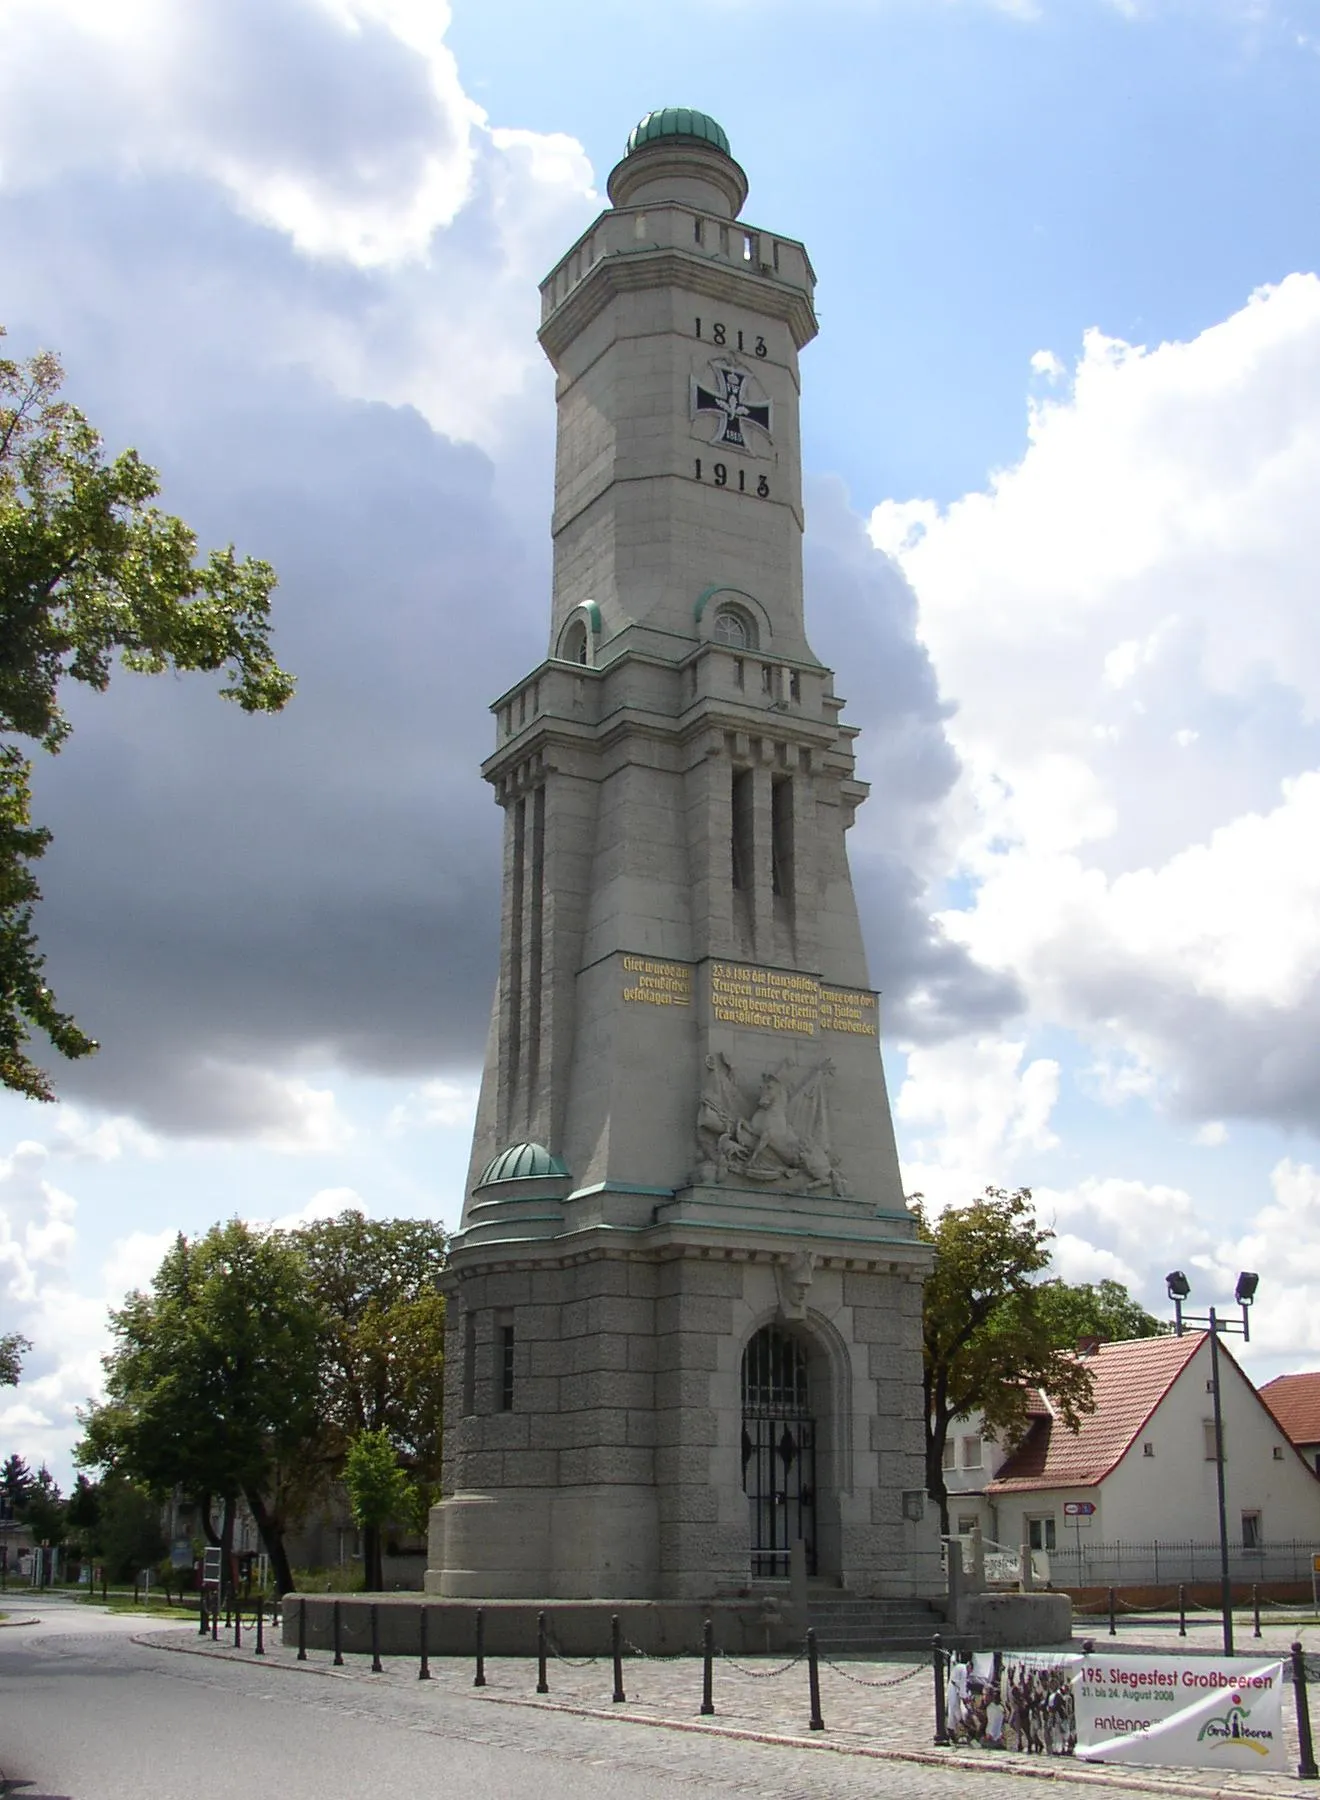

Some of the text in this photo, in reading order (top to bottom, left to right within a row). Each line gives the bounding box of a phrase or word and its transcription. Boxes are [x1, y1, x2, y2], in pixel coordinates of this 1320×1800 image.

[695, 317, 768, 358] 1813
[695, 458, 770, 498] 1913
[623, 955, 644, 972] Hier
[645, 961, 675, 977] wurde
[751, 969, 766, 984] die
[767, 972, 818, 992] französische
[623, 987, 672, 1005] geschlagen
[712, 992, 728, 1007] Der
[728, 994, 748, 1010] Sieg
[791, 1003, 818, 1018] Berlin
[639, 975, 690, 992] preußischen
[712, 978, 752, 996] Truppen
[755, 986, 780, 1000] unter
[781, 988, 818, 1006] General
[714, 1006, 814, 1036] französischer Besetzung
[1081, 1667, 1273, 1689] 195. Siegesfest Großbeeren
[1095, 1688, 1107, 1698] bis
[1108, 1688, 1120, 1699] 24.
[1122, 1689, 1152, 1702] August
[1153, 1690, 1175, 1701] 2008
[1094, 1714, 1151, 1732] Antenne
